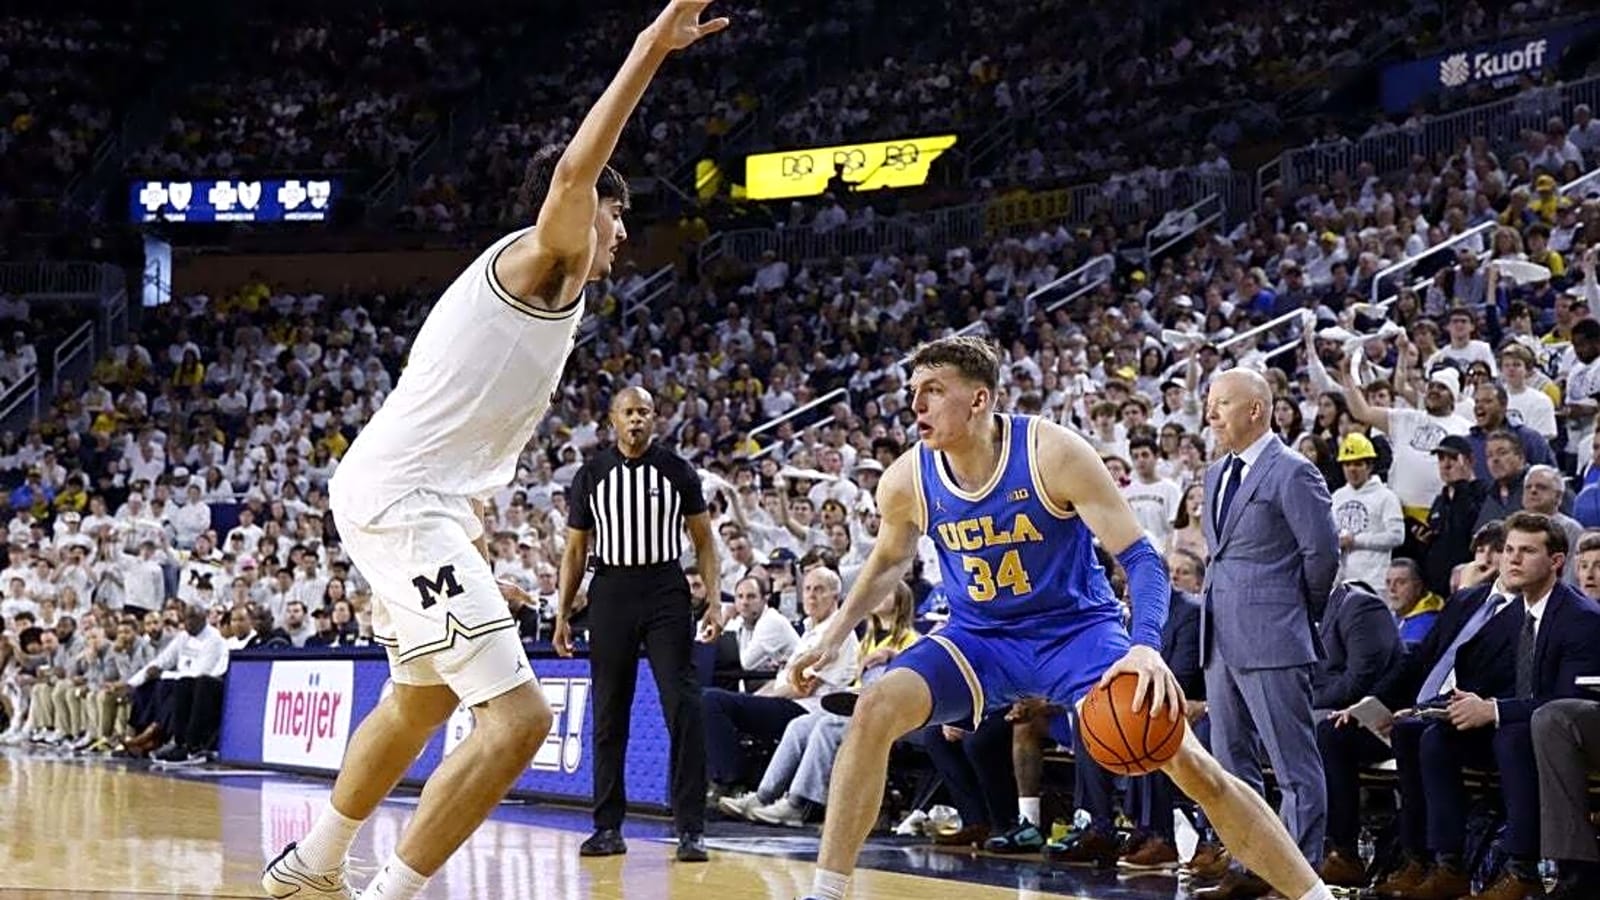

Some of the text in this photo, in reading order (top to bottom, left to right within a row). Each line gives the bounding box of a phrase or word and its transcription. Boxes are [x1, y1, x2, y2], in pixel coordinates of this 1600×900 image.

[1474, 39, 1547, 79] Ruoff
[937, 513, 1043, 551] UCLA
[412, 564, 465, 610] M
[962, 549, 1032, 602] 34
[273, 673, 342, 753] meijer
